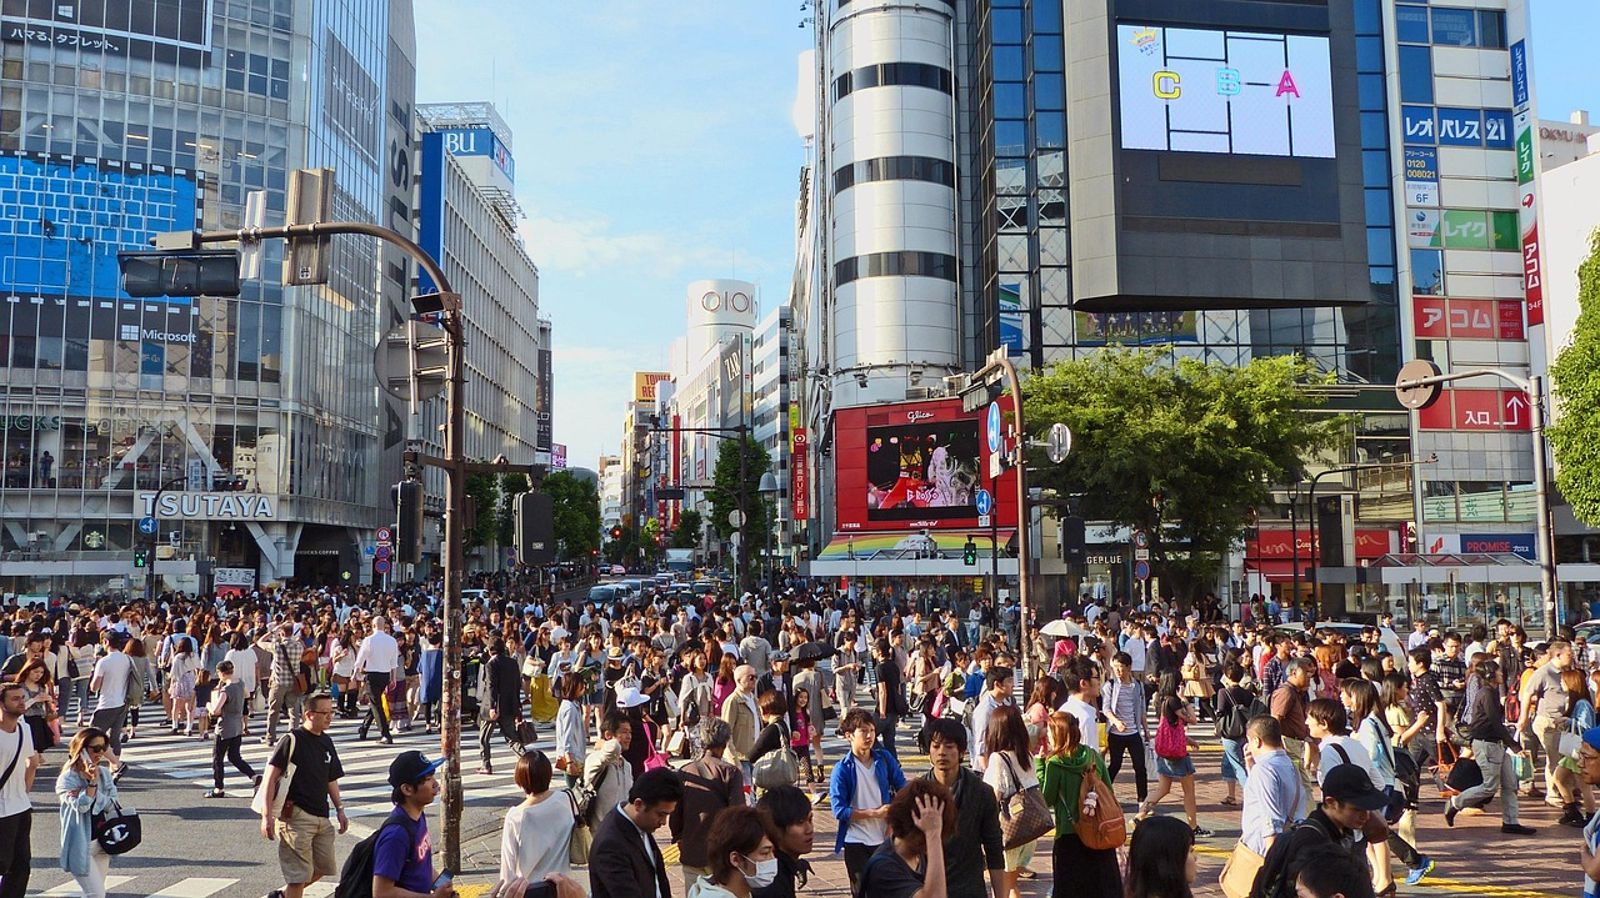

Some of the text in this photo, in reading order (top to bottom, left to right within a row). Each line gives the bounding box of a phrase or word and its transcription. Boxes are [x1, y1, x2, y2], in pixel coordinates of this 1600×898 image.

[11, 28, 119, 51] ハマる、タブレット。
[1153, 68, 1300, 99] C B A
[1406, 118, 1506, 141] レオパレス21
[1539, 127, 1573, 142] OKYU
[1407, 159, 1425, 168] 0120
[1520, 142, 1531, 174] レイク
[1416, 193, 1428, 203] 6F
[1445, 221, 1487, 238] レイク
[1525, 242, 1540, 289] アコム
[1422, 308, 1491, 329] アコム
[143, 329, 197, 343] Microsoft
[907, 410, 935, 422] Glico
[1465, 410, 1490, 426] 入口
[140, 494, 273, 517] TSUTAYA
[1466, 541, 1510, 552] PROMISE
